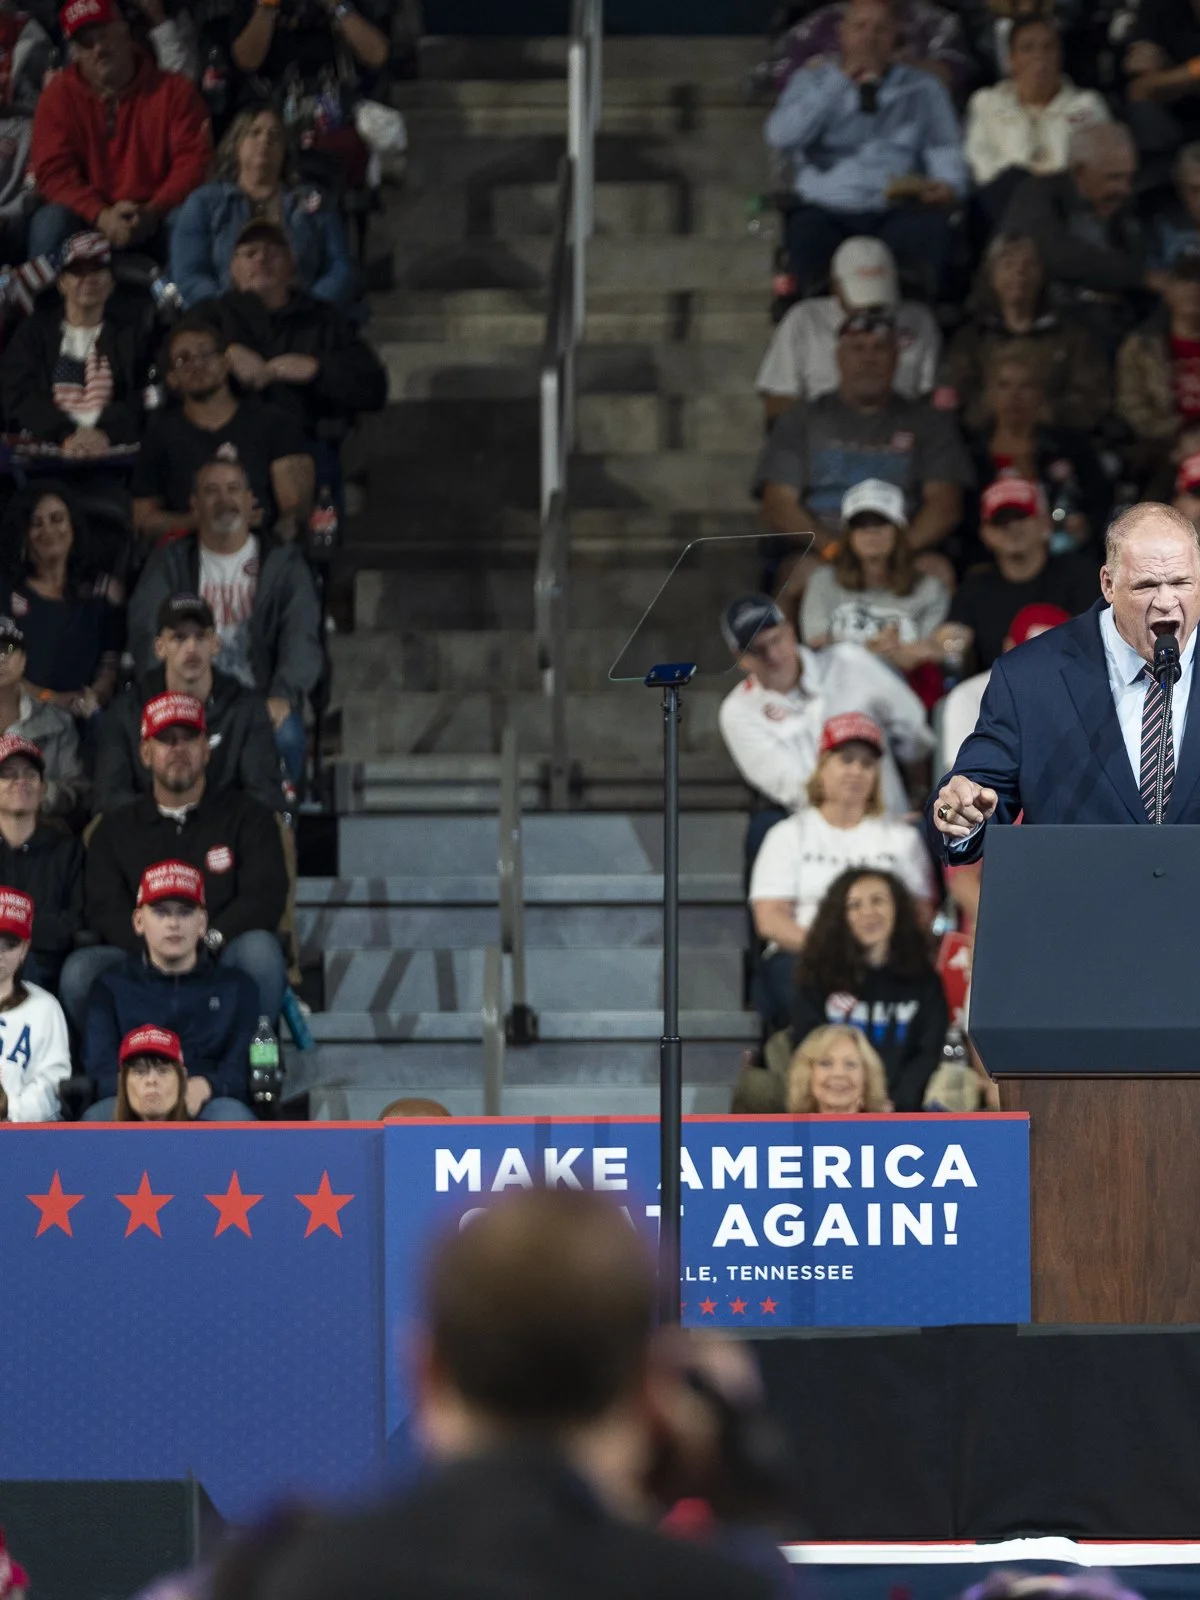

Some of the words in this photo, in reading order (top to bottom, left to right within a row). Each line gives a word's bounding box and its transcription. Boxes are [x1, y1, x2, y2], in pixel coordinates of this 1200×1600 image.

[435, 1147, 628, 1192] MAKE
[712, 1203, 958, 1247] AGAIN!
[727, 1265, 854, 1281] TENNESSEE
